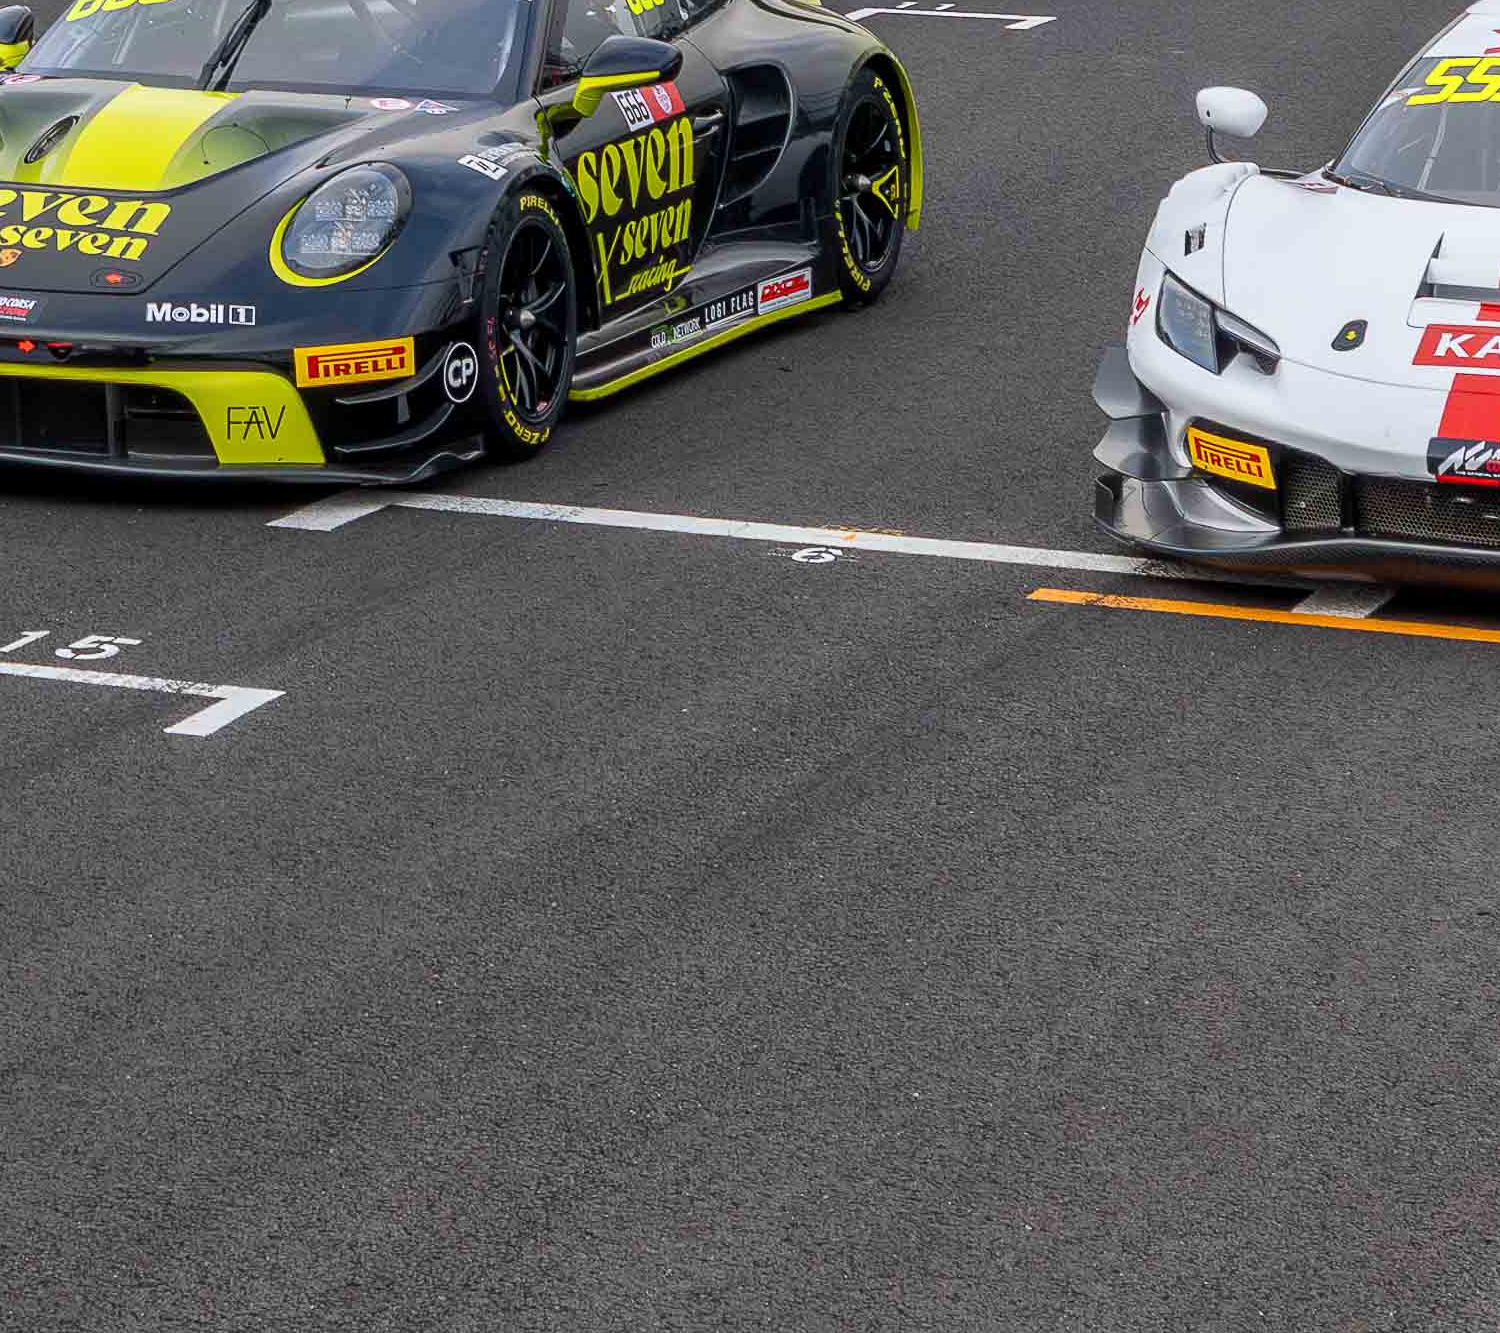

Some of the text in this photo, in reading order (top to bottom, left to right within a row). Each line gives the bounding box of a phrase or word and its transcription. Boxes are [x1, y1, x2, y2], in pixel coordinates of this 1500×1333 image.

[619, 91, 651, 129] 666
[577, 116, 697, 226] seven
[620, 197, 692, 266] seven
[622, 255, 688, 298] racing
[146, 301, 224, 325] Mobil
[730, 290, 755, 315] FLAG
[307, 345, 408, 380] PIRELLI
[448, 354, 475, 390] CP
[1194, 436, 1264, 478] PIRELLI
